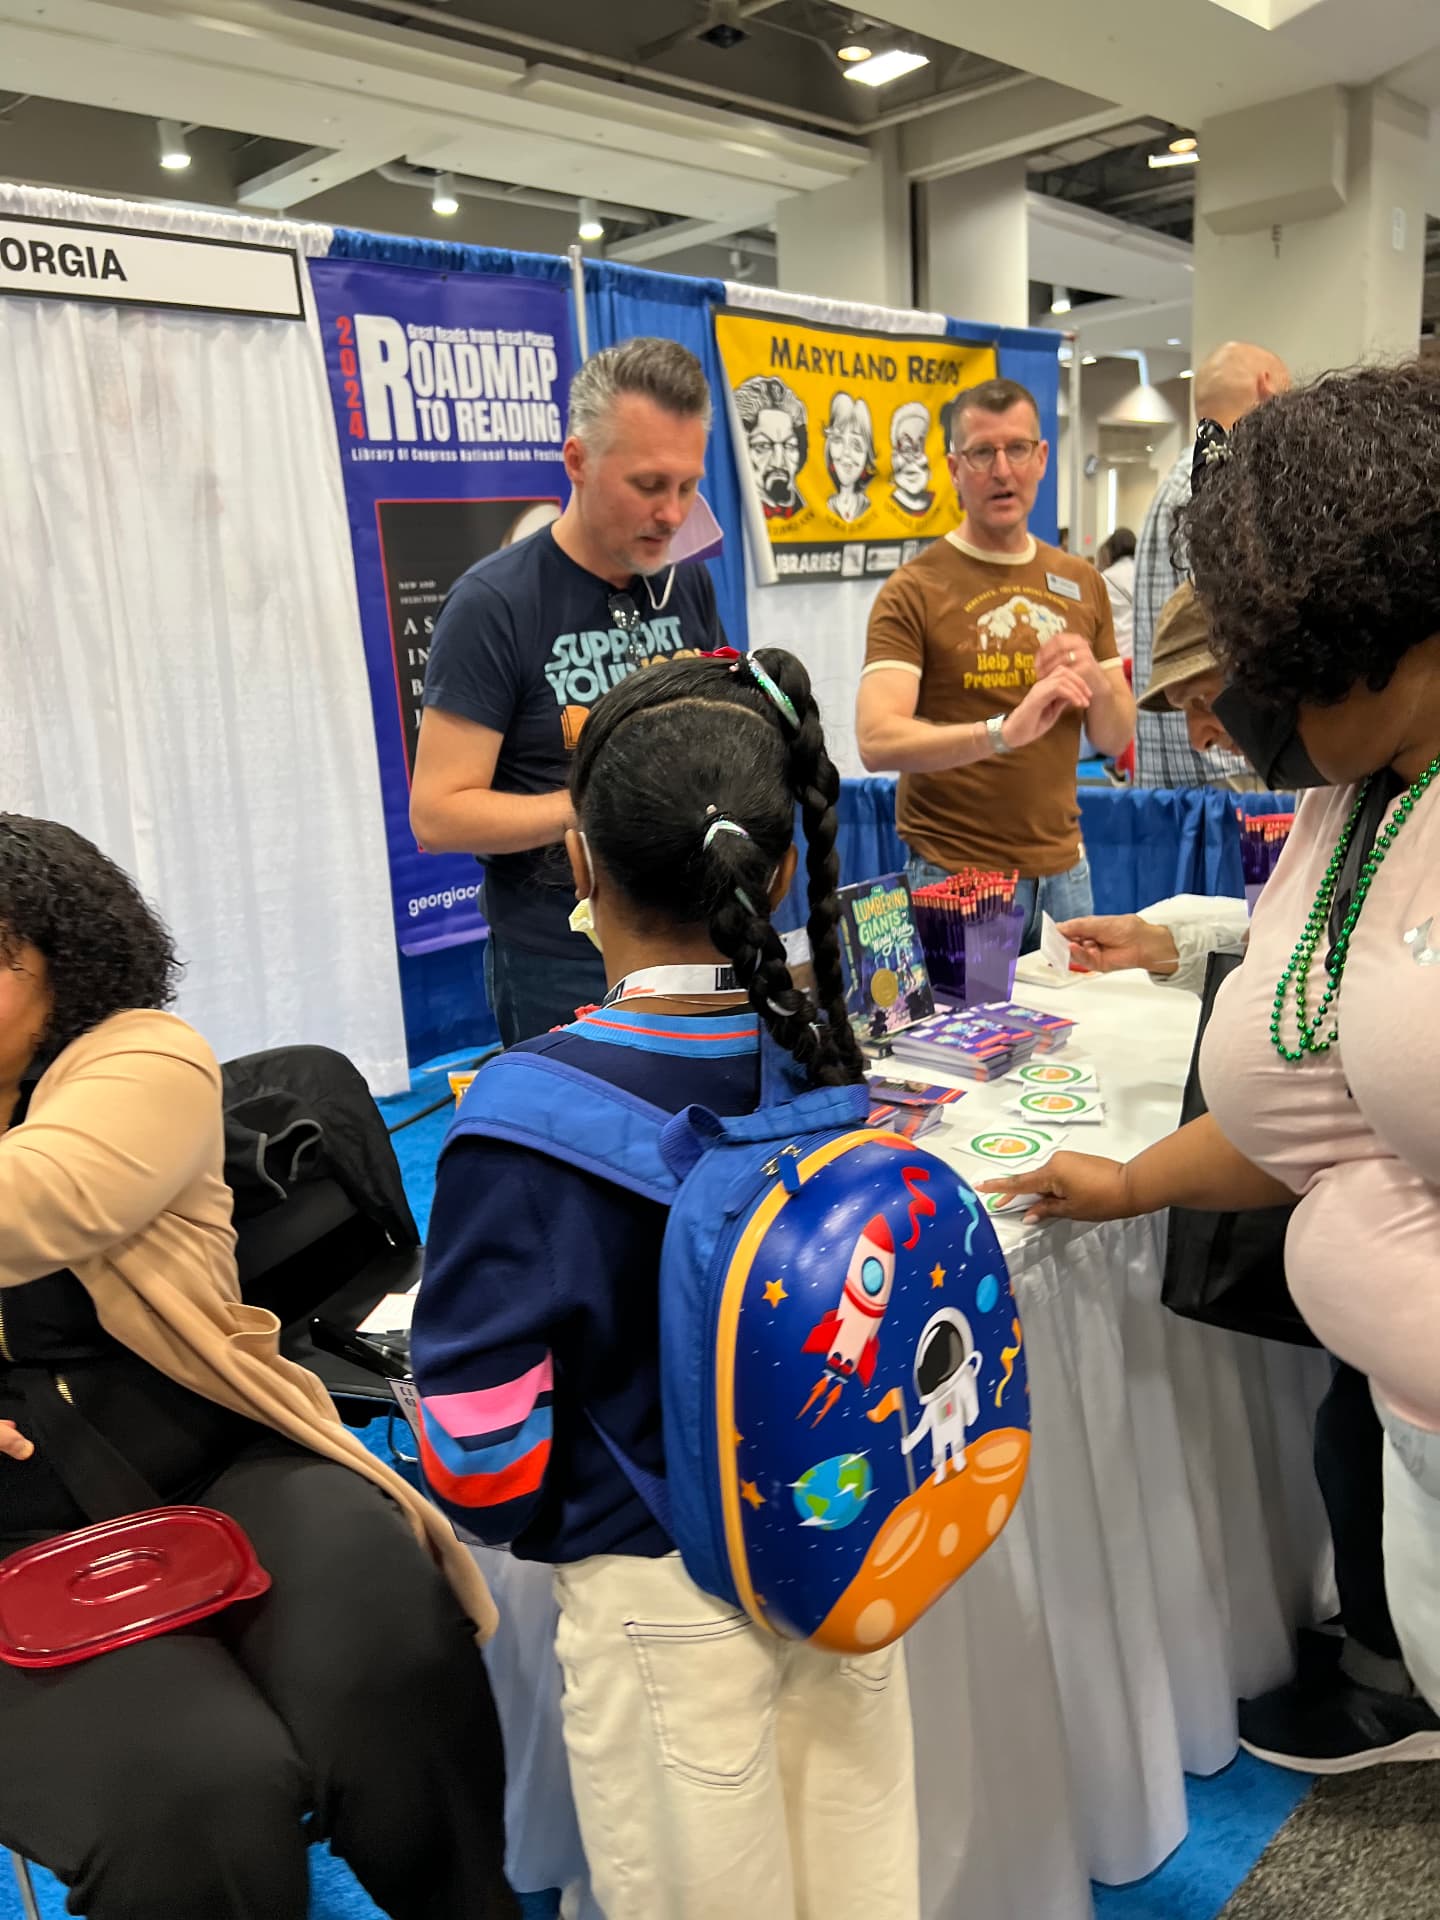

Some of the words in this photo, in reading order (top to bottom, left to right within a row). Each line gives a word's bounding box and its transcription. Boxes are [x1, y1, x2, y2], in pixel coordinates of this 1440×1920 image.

[0, 236, 128, 282] ORGIA
[336, 316, 365, 440] 2024
[353, 314, 558, 442] ROADMAP
[770, 335, 898, 382] MARYLAND
[416, 400, 451, 442] TO
[454, 401, 562, 443] READING
[351, 448, 395, 463] Library
[411, 448, 459, 463] Congress
[404, 617, 418, 636] A
[545, 616, 684, 673] SUPPORT
[963, 668, 1020, 688] Prevent
[977, 650, 1010, 672] Help
[852, 887, 909, 924] LUMBERING
[859, 911, 901, 946] GIANTS
